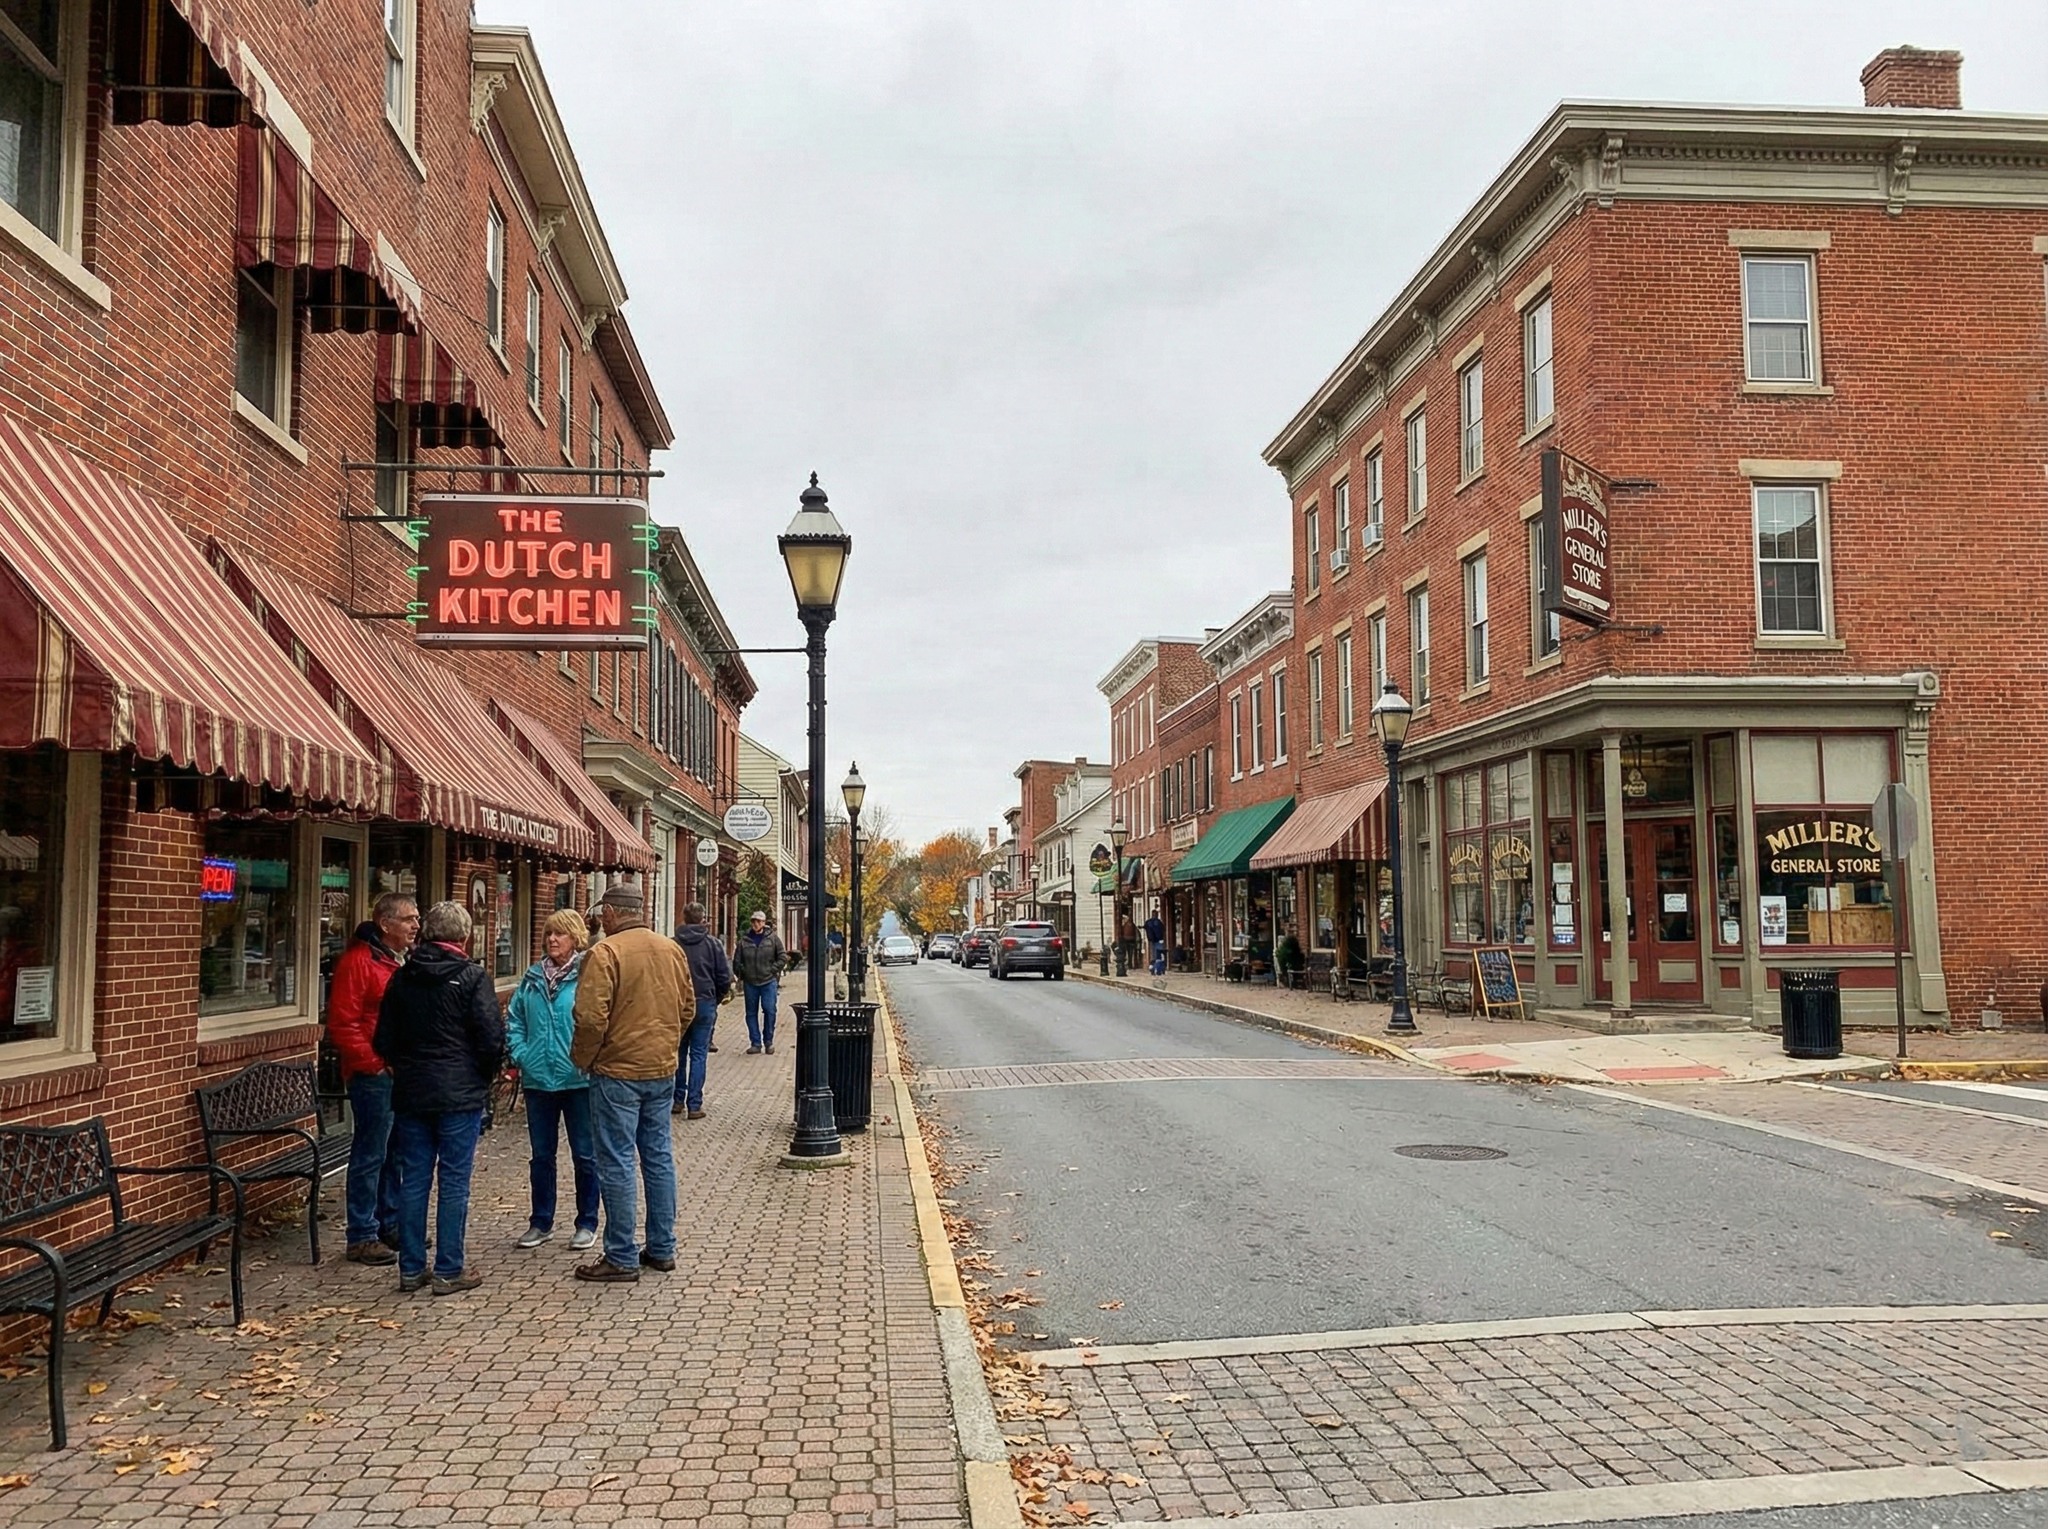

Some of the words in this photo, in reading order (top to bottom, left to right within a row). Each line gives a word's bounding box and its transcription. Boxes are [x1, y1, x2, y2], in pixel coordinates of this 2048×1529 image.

[498, 509, 563, 533] THE
[1563, 508, 1608, 549] MILLER'S
[448, 539, 611, 580] DUTCH
[1565, 536, 1607, 570] GENERAL
[1572, 563, 1602, 590] STORE
[439, 588, 621, 626] KITCHEN
[480, 806, 498, 831] THE
[499, 811, 527, 837] DUTCH
[1765, 821, 1882, 856] MILLER'S
[1771, 858, 1833, 874] GENERAL
[1837, 858, 1882, 874] STORE
